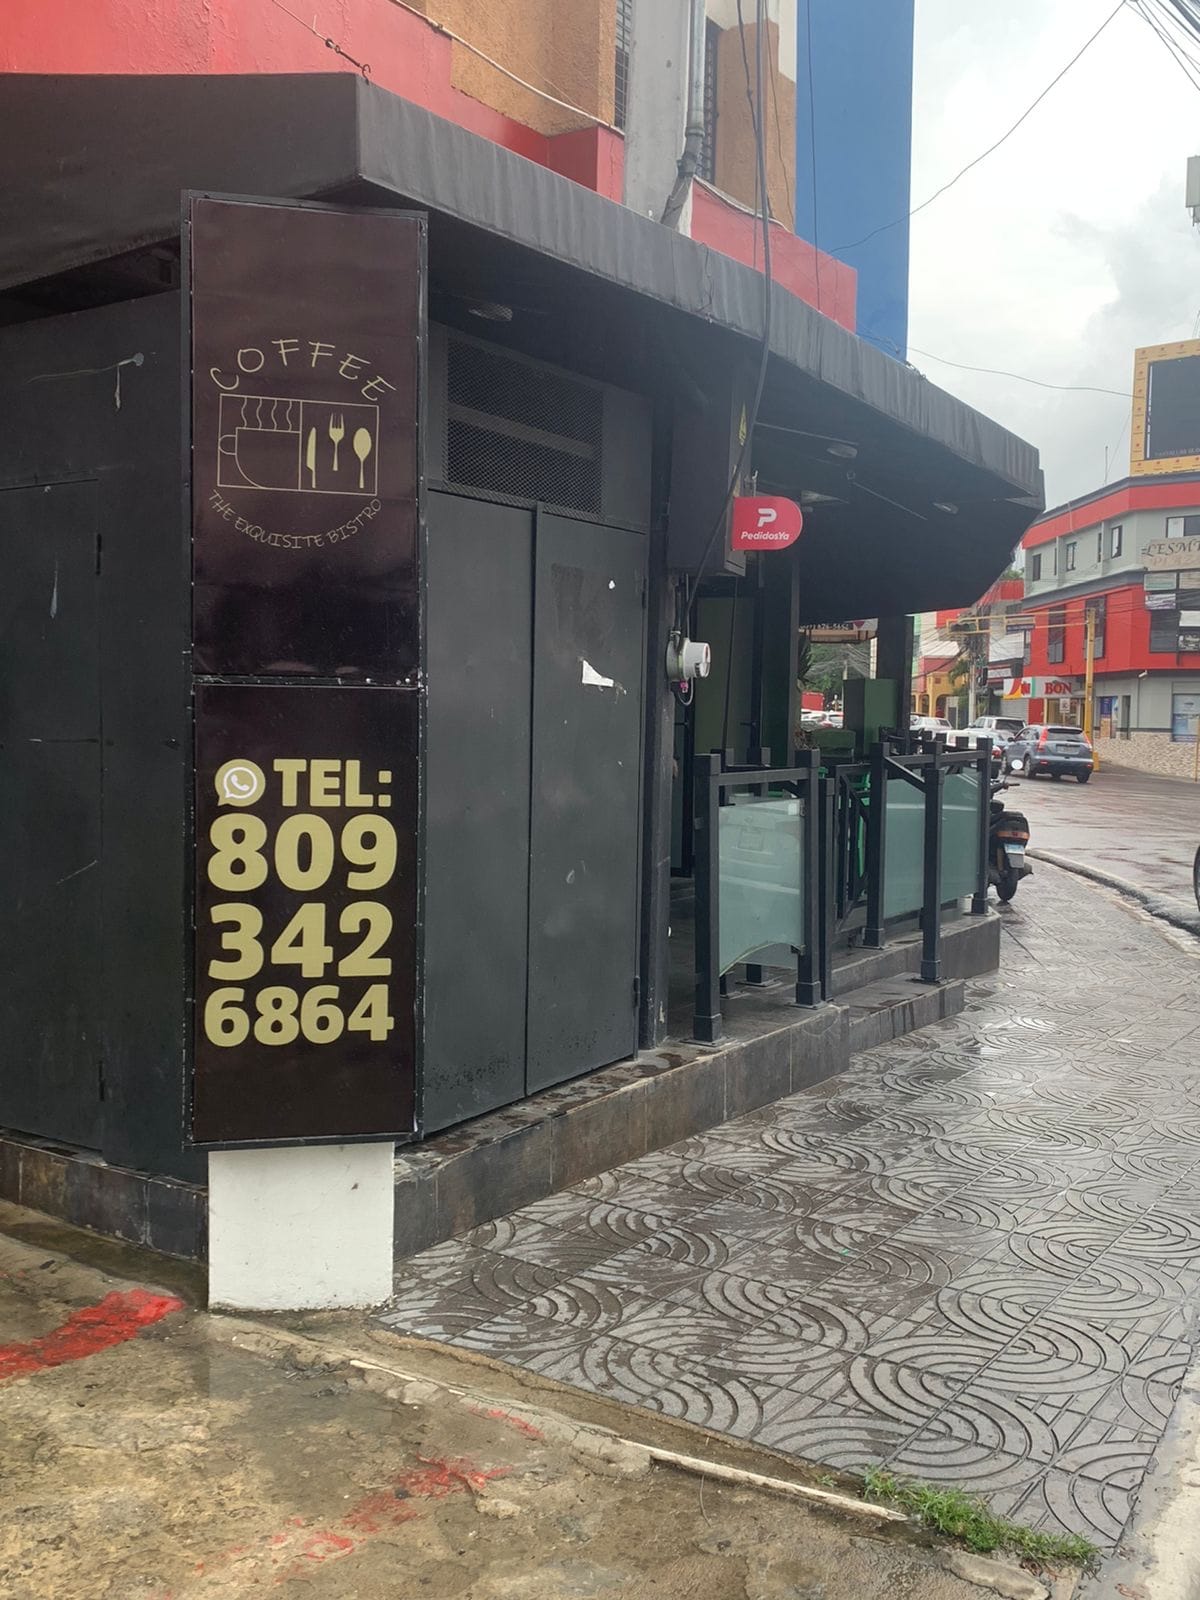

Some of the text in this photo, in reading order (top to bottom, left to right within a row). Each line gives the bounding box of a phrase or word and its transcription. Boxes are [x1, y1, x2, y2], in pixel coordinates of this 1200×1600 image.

[209, 338, 398, 402] COFFEE
[208, 488, 382, 550] THE EXQUISITE BISTRO
[740, 530, 790, 542] PedidosYa
[1044, 681, 1073, 695] BON
[272, 758, 393, 808] TEL:
[207, 812, 398, 892] 809
[207, 900, 394, 981] 342
[203, 983, 395, 1048] 6864
